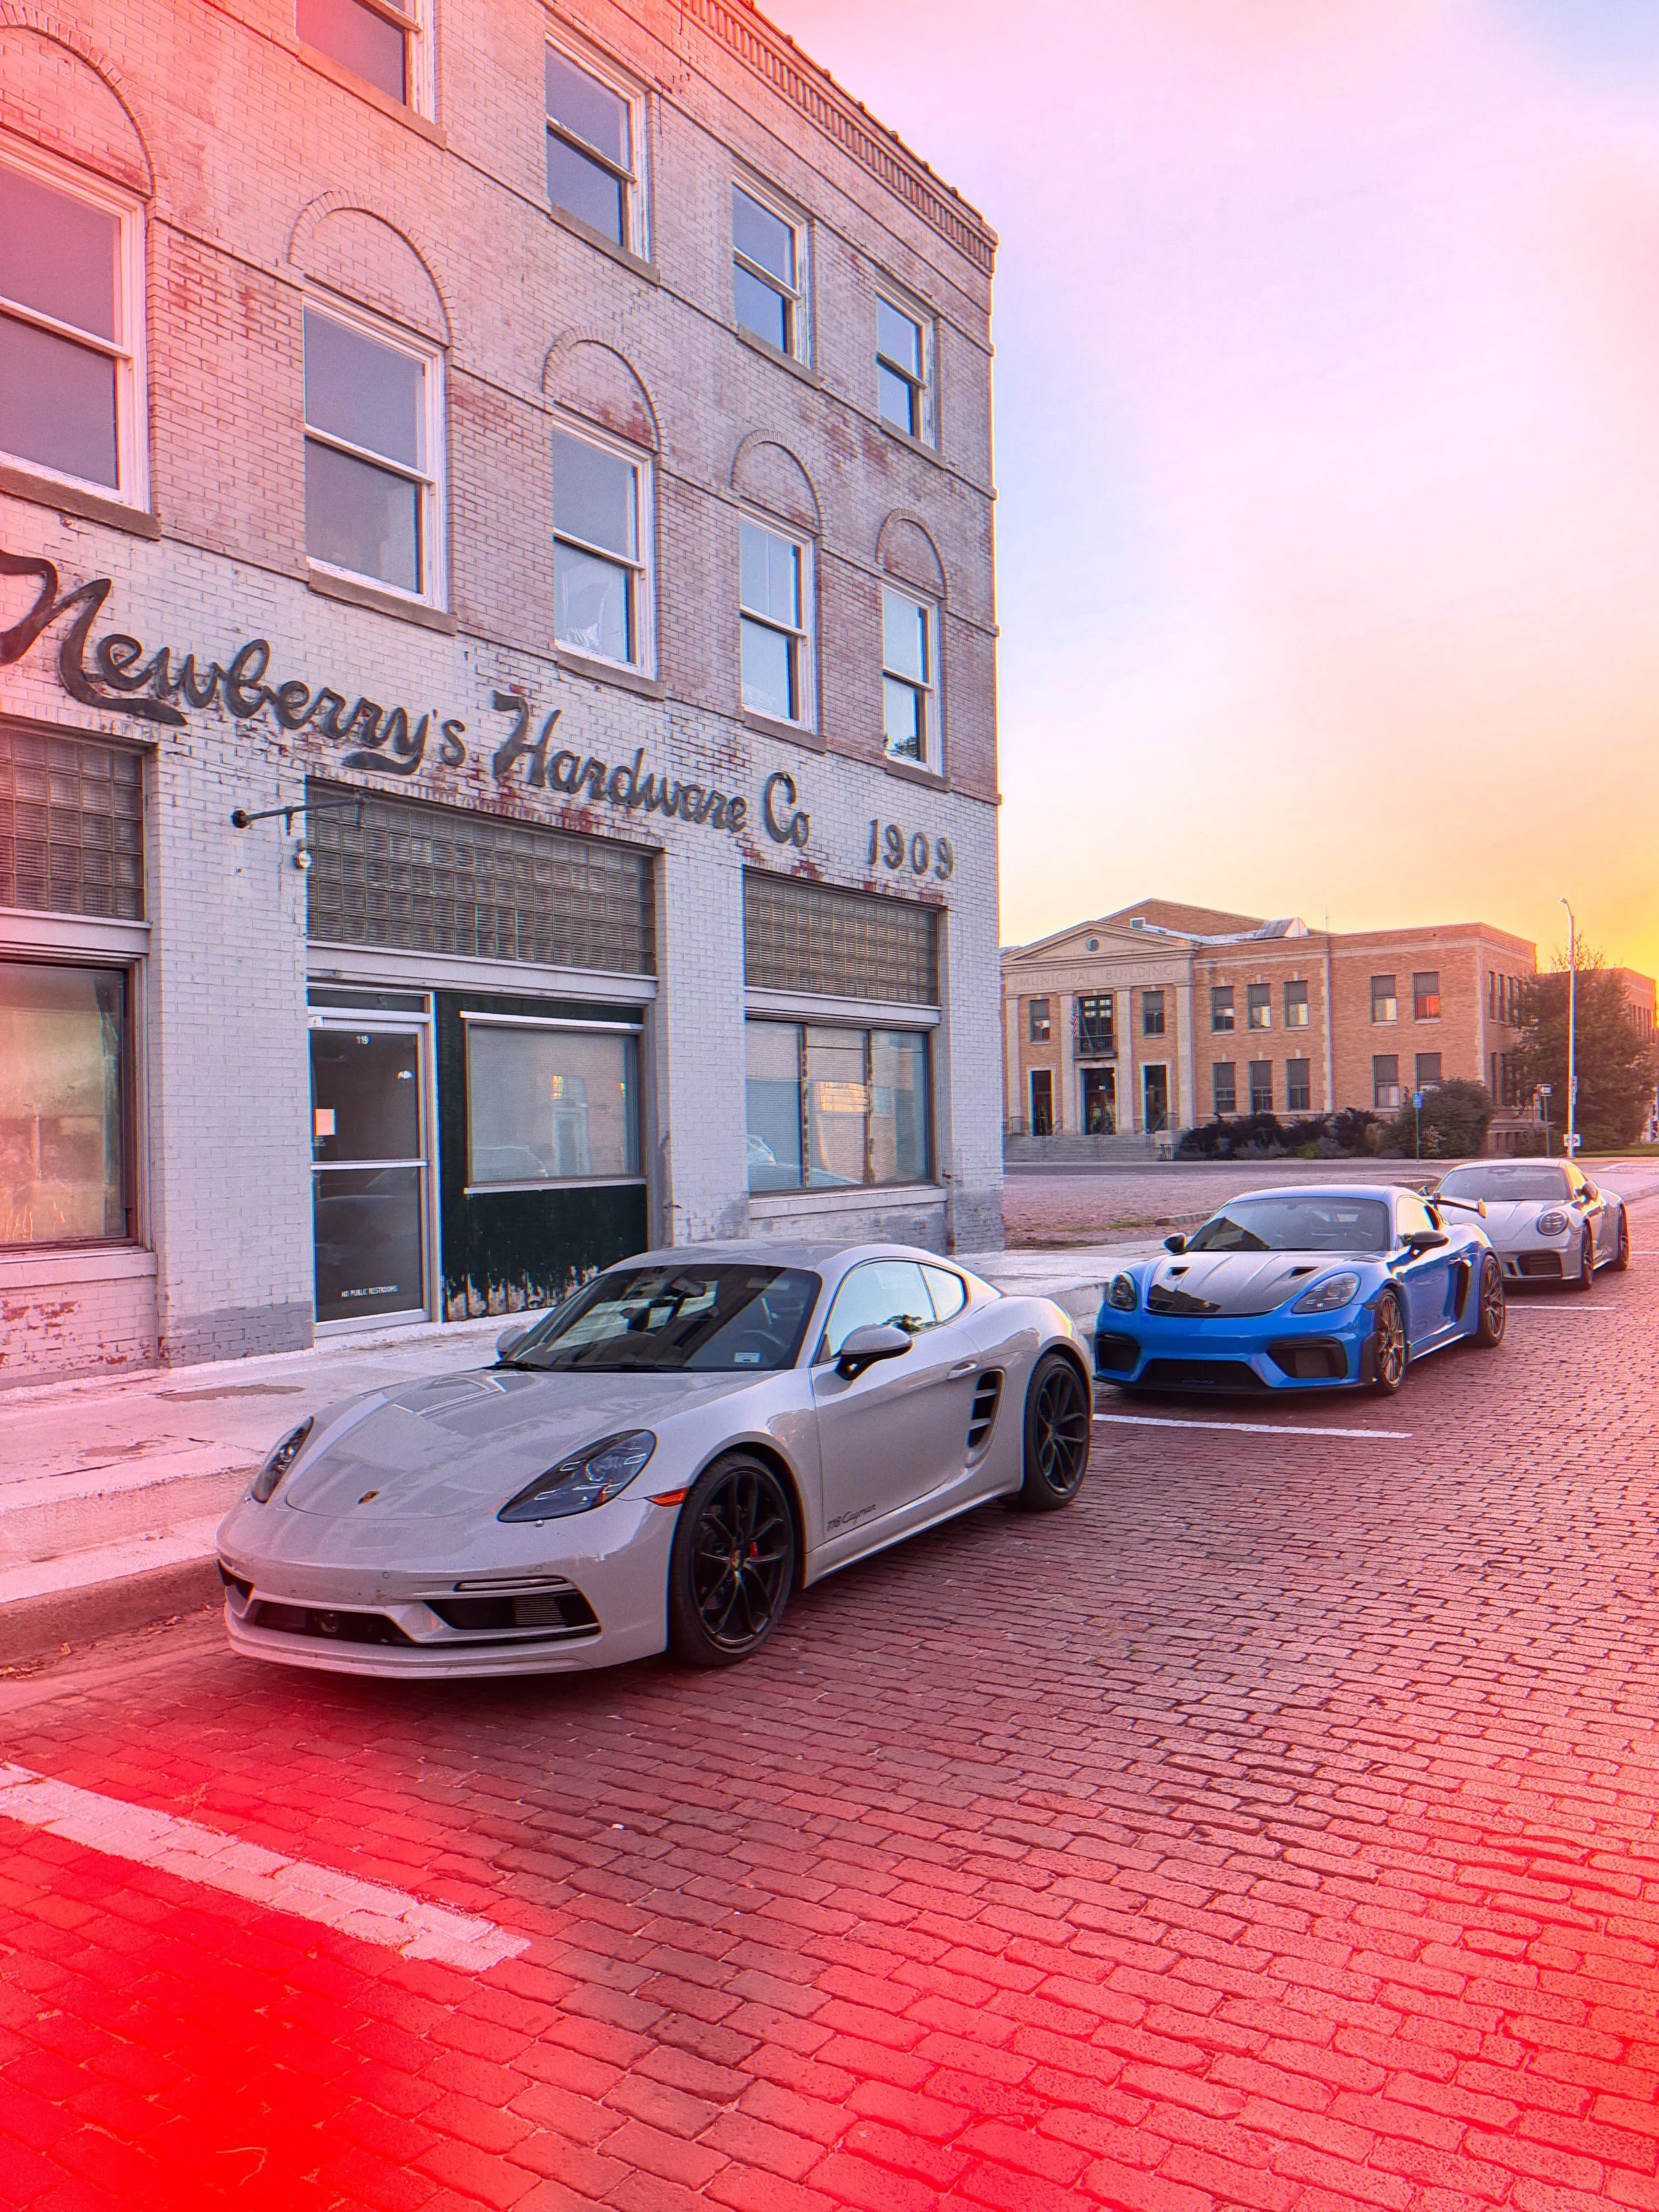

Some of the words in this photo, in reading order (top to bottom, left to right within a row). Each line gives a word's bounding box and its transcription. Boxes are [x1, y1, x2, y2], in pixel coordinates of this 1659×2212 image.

[0, 550, 466, 775] Newberry's
[492, 690, 747, 833] Hardware
[764, 771, 810, 848] Co
[869, 818, 954, 880] 1909
[1019, 971, 1095, 988] MUNICIPAL
[1105, 964, 1174, 981] BUILDING
[356, 1035, 370, 1045] 119
[350, 1288, 368, 1297] PUBLIC
[368, 1285, 399, 1295] RESTROOMS
[842, 1504, 876, 1526] Cayman
